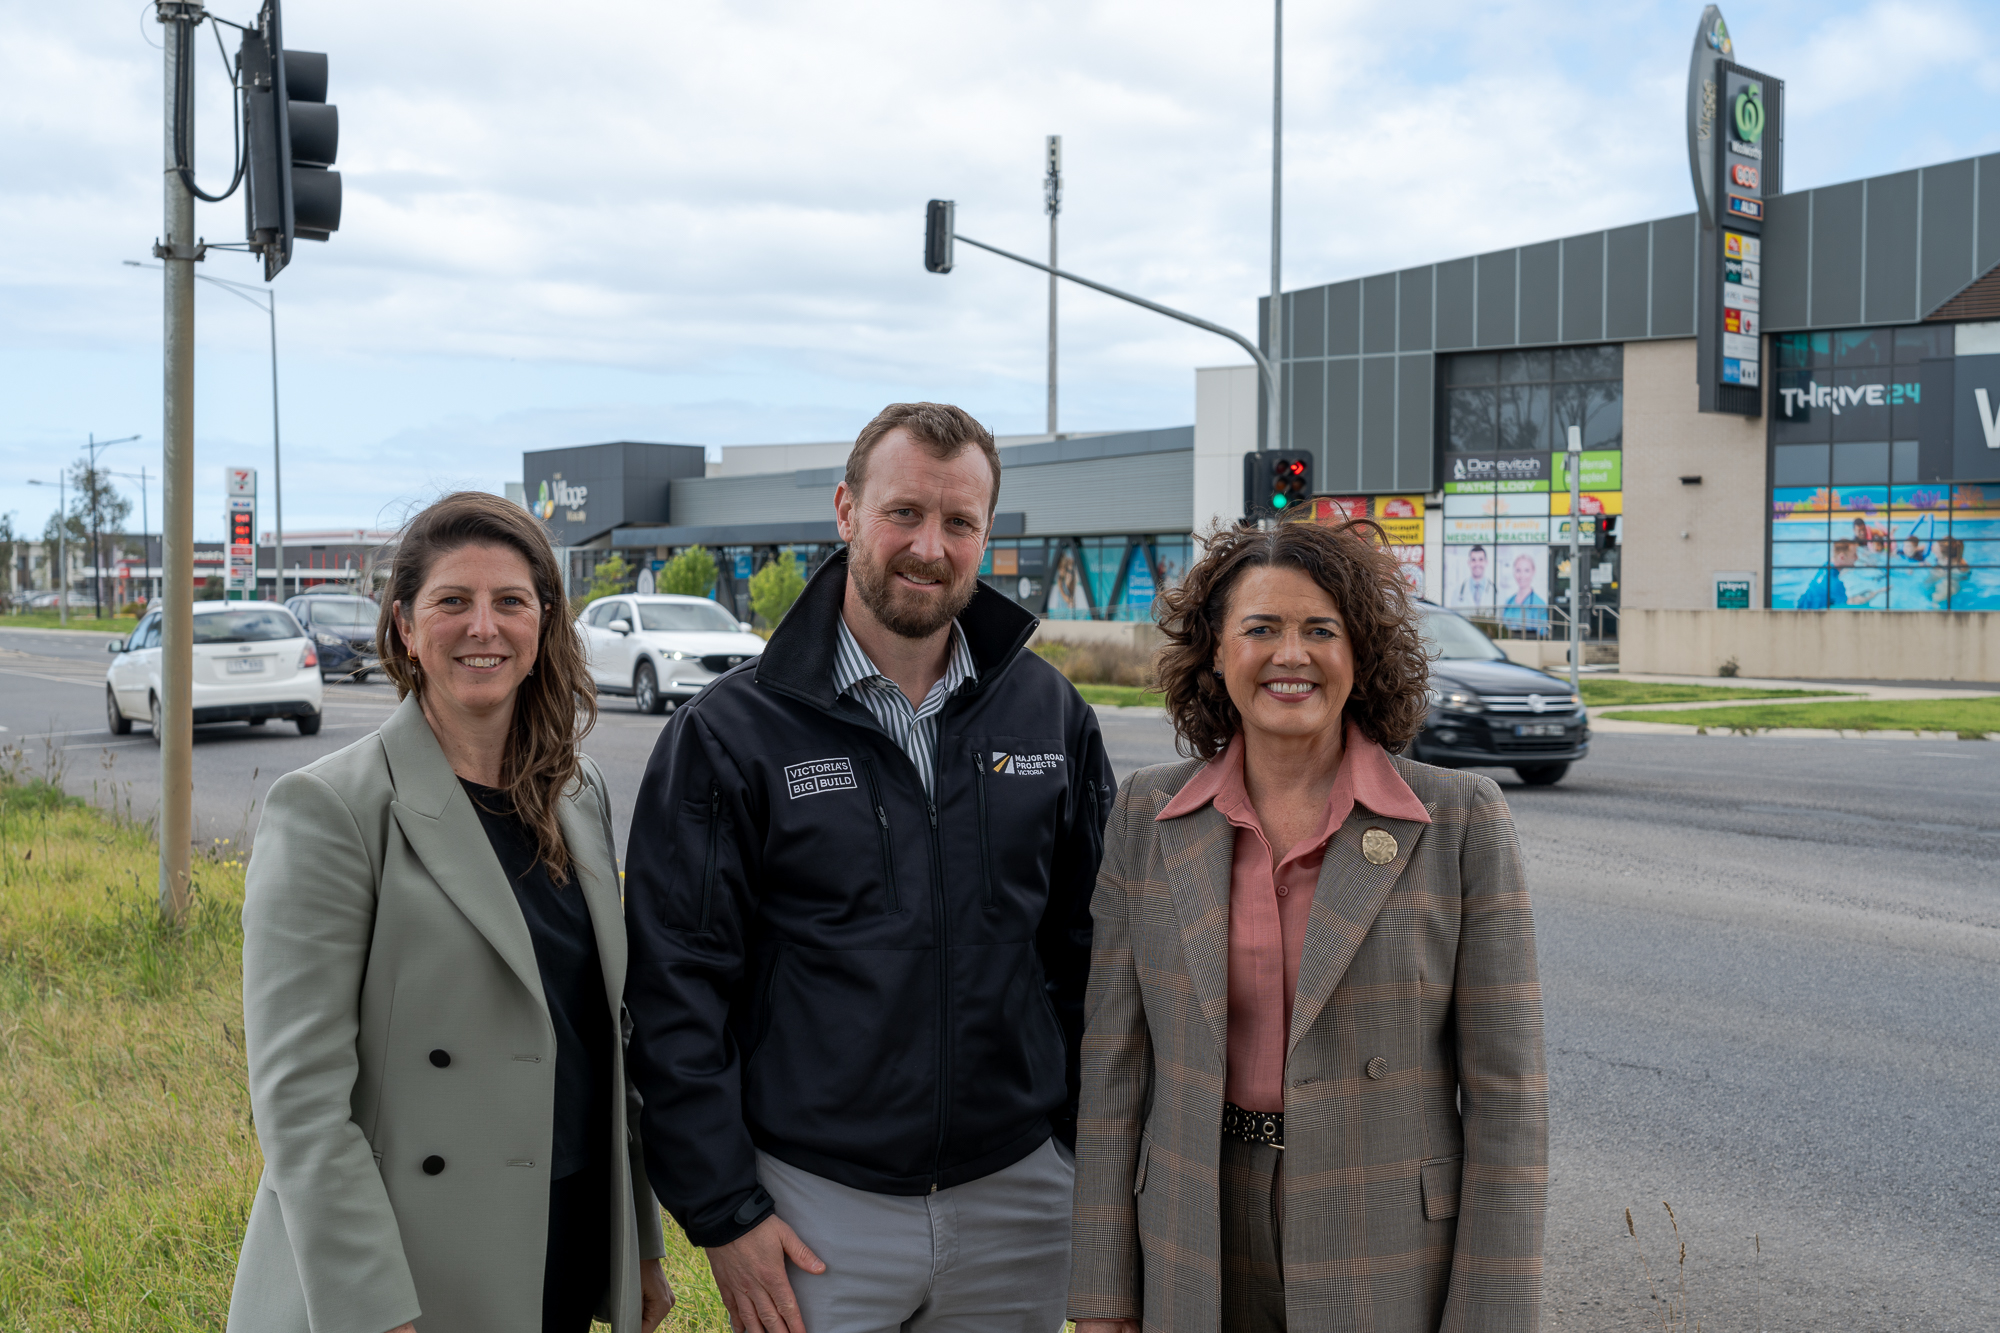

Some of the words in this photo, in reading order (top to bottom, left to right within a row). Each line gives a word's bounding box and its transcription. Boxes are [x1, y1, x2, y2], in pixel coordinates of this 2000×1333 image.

[1741, 200, 1759, 216] ALDI
[1456, 481, 1536, 492] PATHOLOGY
[552, 480, 588, 510] Village
[1015, 754, 1042, 762] MAJOR
[1043, 753, 1065, 762] ROAD
[1016, 761, 1057, 769] PROJECTS
[790, 762, 848, 778] VICTORIA'S
[793, 782, 814, 794] BIG
[820, 776, 852, 788] BUILD
